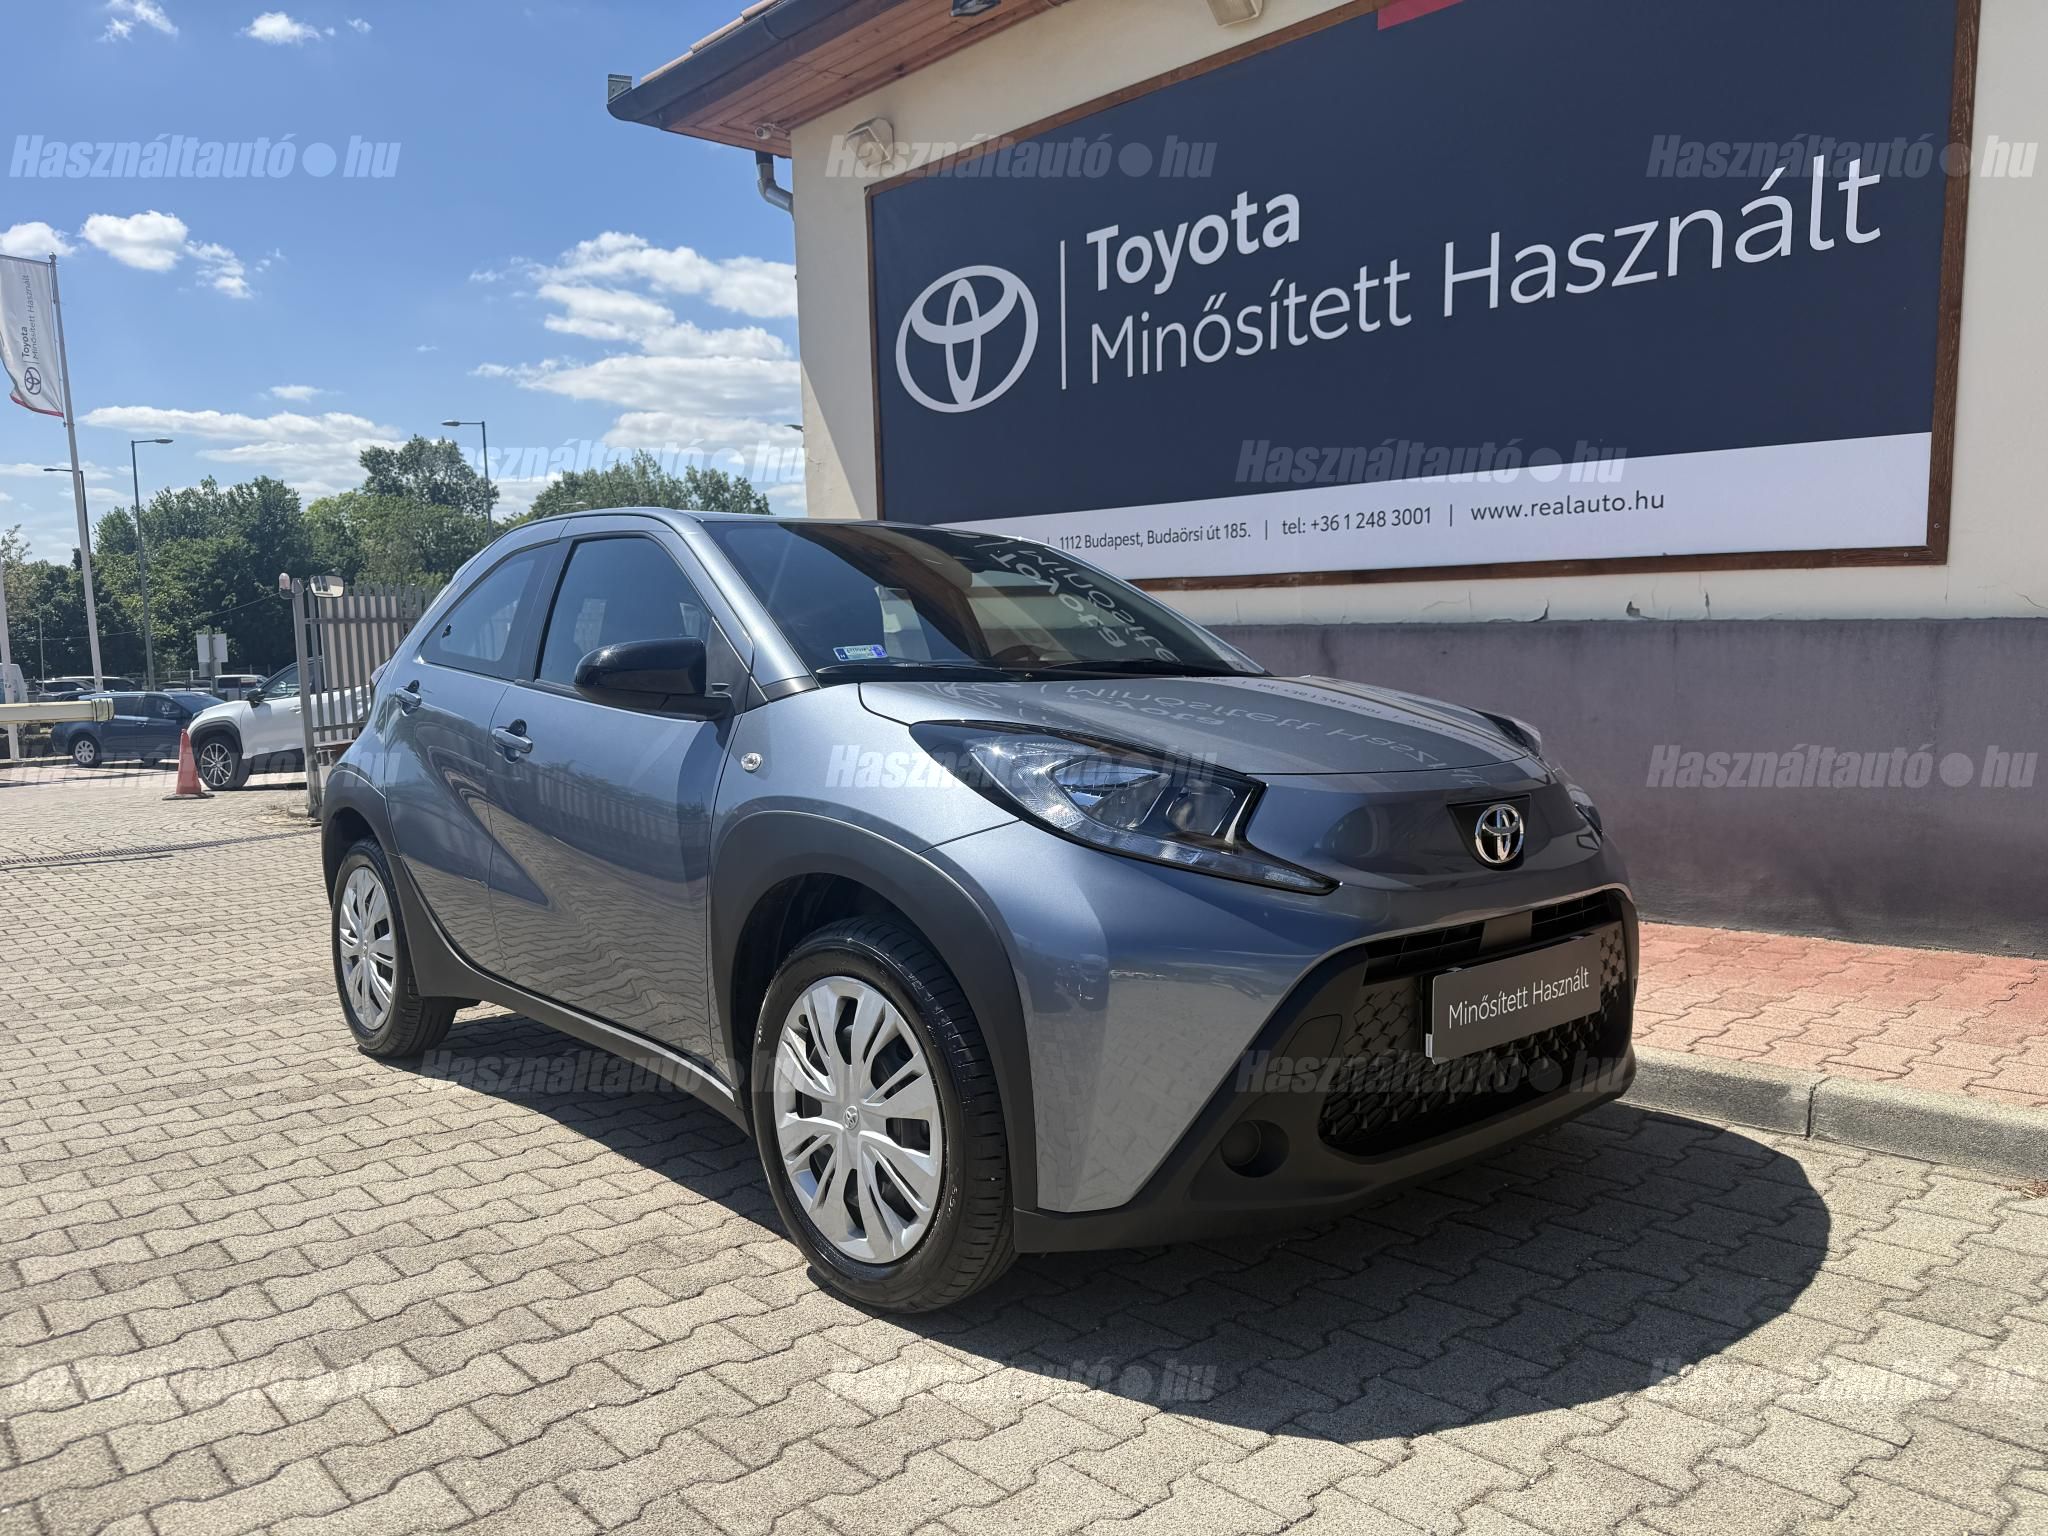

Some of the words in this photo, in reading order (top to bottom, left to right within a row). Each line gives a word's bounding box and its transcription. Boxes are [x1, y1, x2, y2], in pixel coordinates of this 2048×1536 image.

[1086, 191, 1299, 295] Toyota
[1091, 259, 1412, 384] Minősített
[1443, 154, 1881, 317] Használt
[21, 326, 32, 359] Toyota
[1059, 535, 1082, 550] 1112
[1085, 532, 1144, 550] Budapest,
[1147, 525, 1204, 545] Budaörsi
[1207, 524, 1221, 541] út
[1223, 522, 1251, 539] 185.
[1282, 516, 1306, 535] tel:
[1311, 514, 1340, 532] +36
[1356, 510, 1387, 529] 248
[1391, 506, 1432, 527] 3001
[1471, 490, 1665, 522] www.realauto.hu
[1448, 984, 1529, 1030] Minősített
[1533, 966, 1590, 1006] Használt
